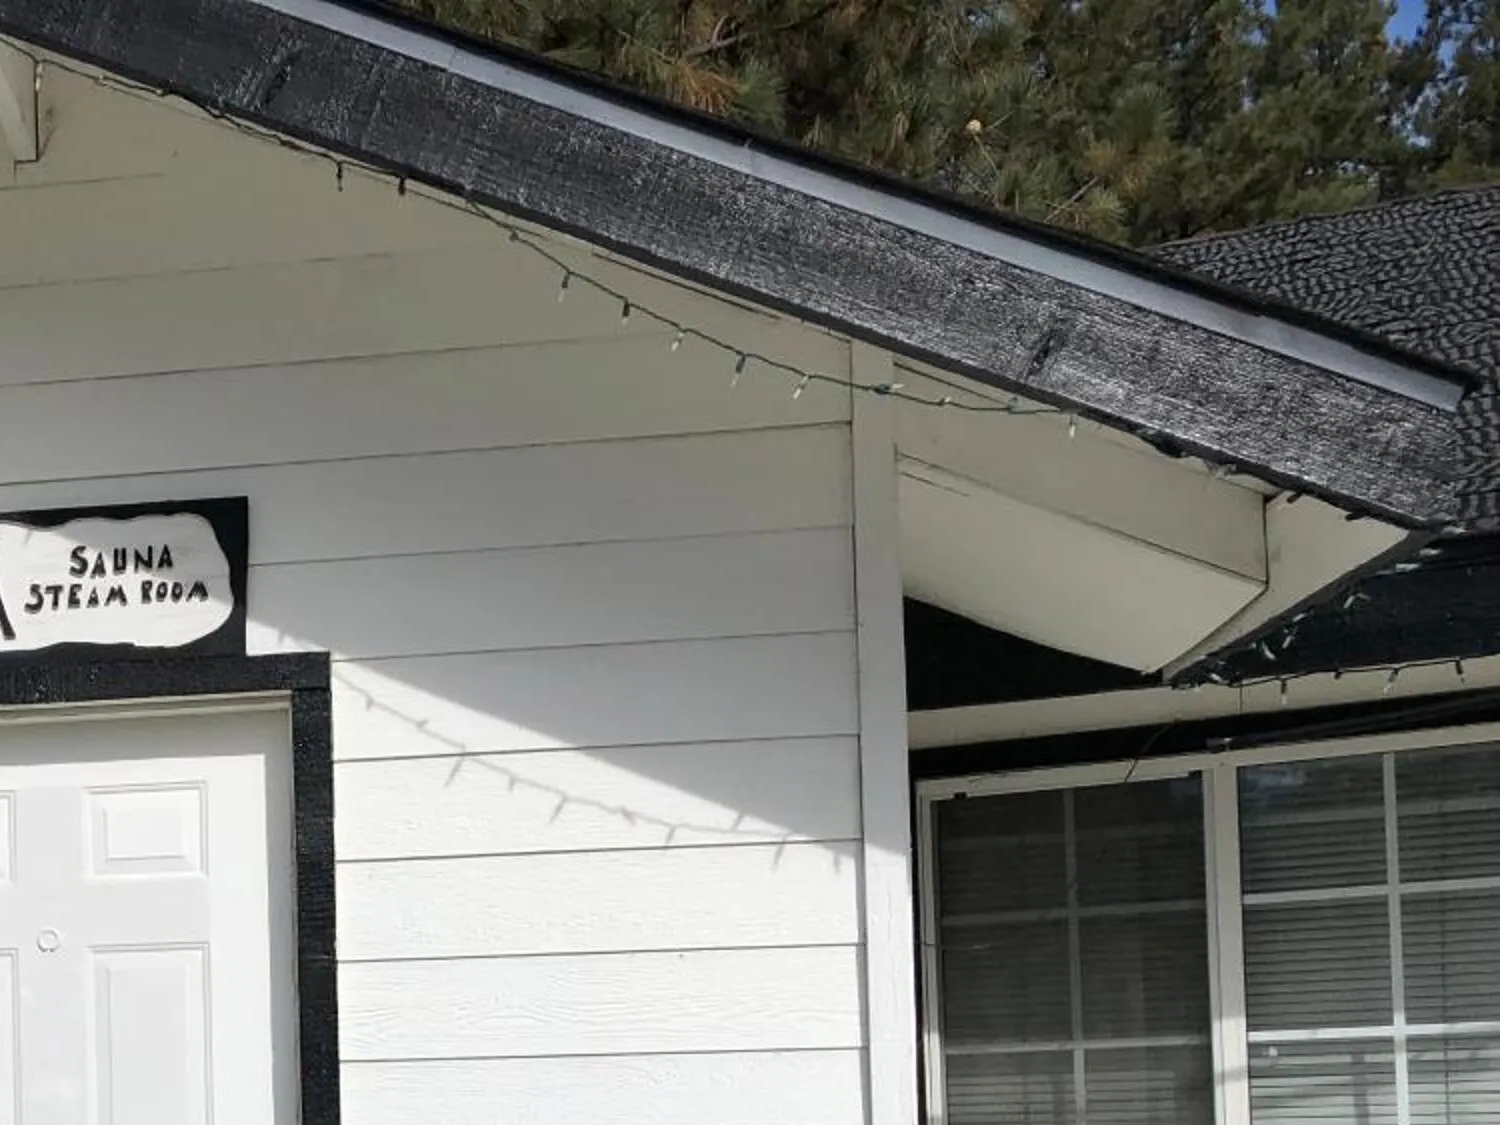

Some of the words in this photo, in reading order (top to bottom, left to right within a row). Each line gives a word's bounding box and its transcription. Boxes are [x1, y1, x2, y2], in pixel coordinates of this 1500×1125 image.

[69, 543, 175, 578] SAUNA
[24, 583, 128, 614] STEAM
[141, 580, 209, 604] ROOM
